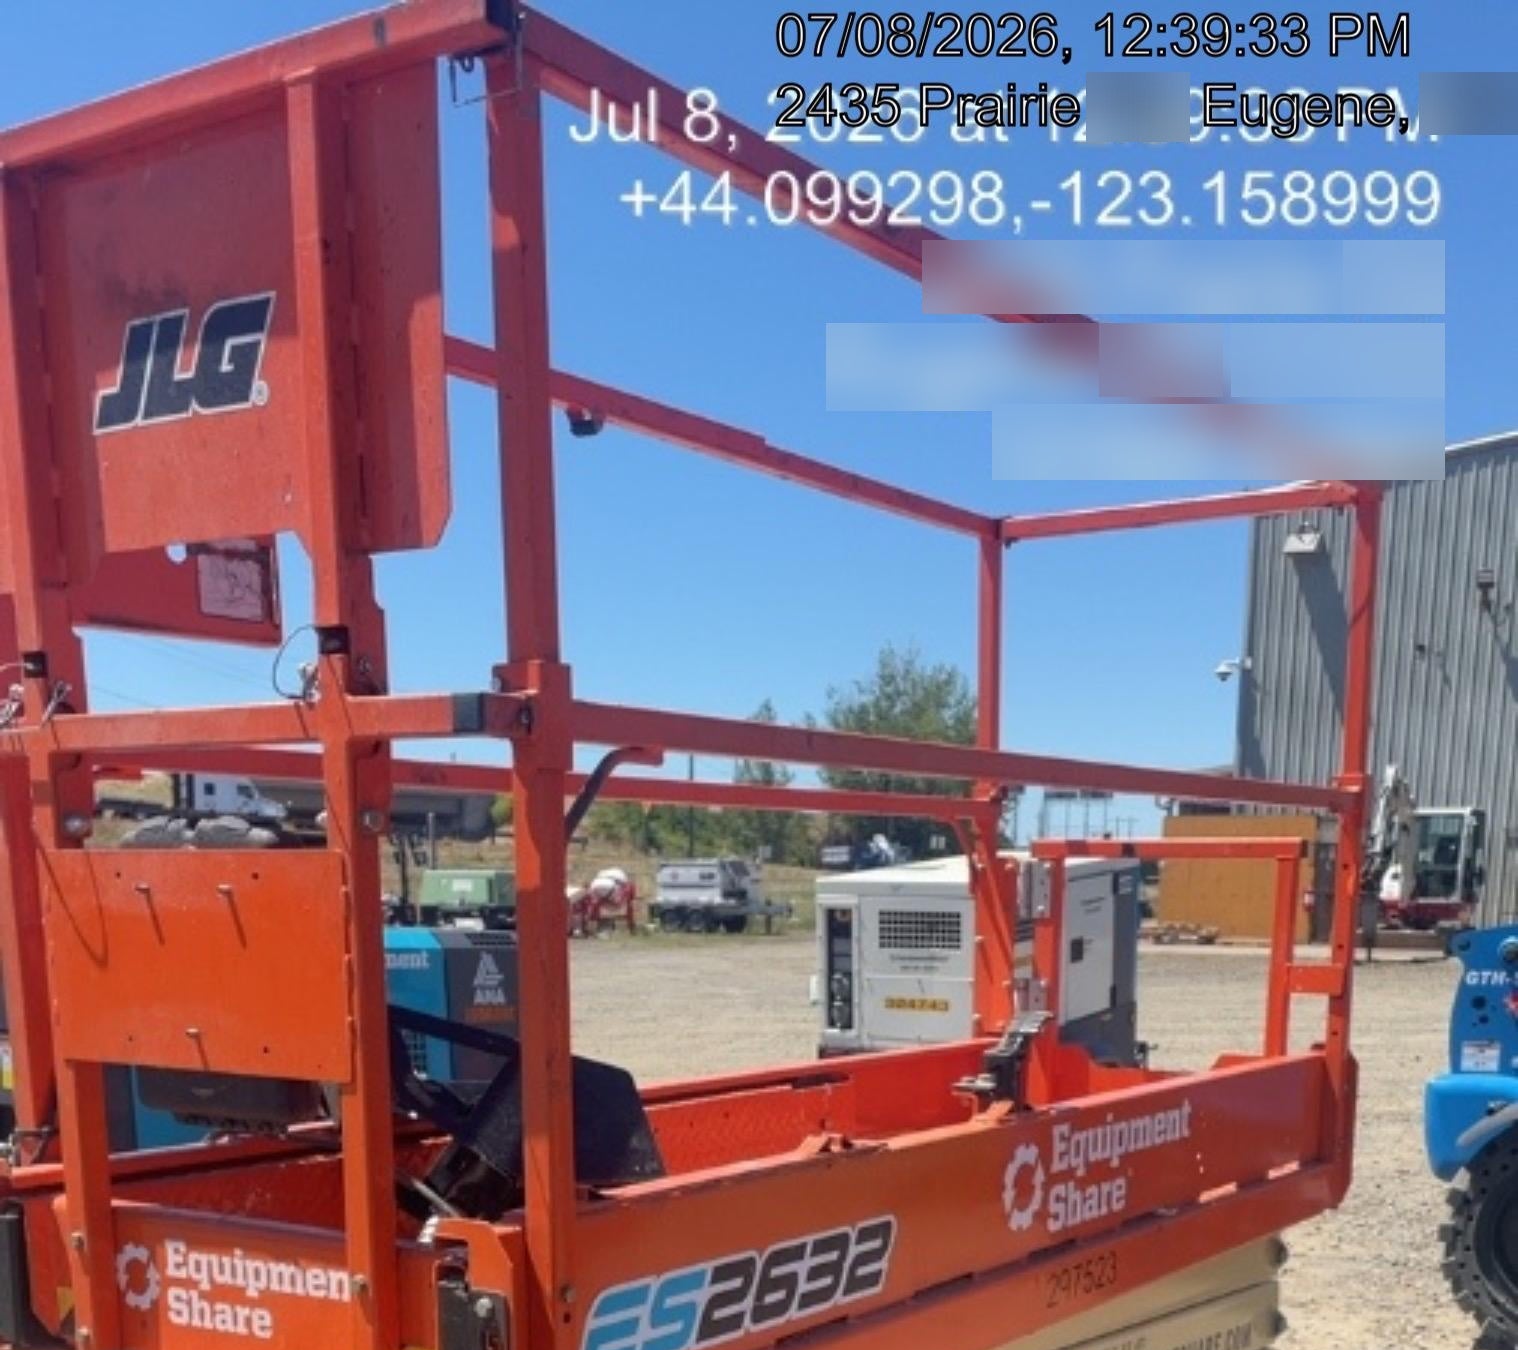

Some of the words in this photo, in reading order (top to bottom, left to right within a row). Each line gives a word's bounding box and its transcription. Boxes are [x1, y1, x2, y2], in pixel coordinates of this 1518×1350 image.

[93, 290, 276, 435] JLG
[1051, 1098, 1192, 1176] Equipment
[1047, 1177, 1126, 1233] Share
[165, 1239, 350, 1302] Equipmen
[1046, 1250, 1117, 1309] 297523
[167, 1286, 273, 1339] Share
